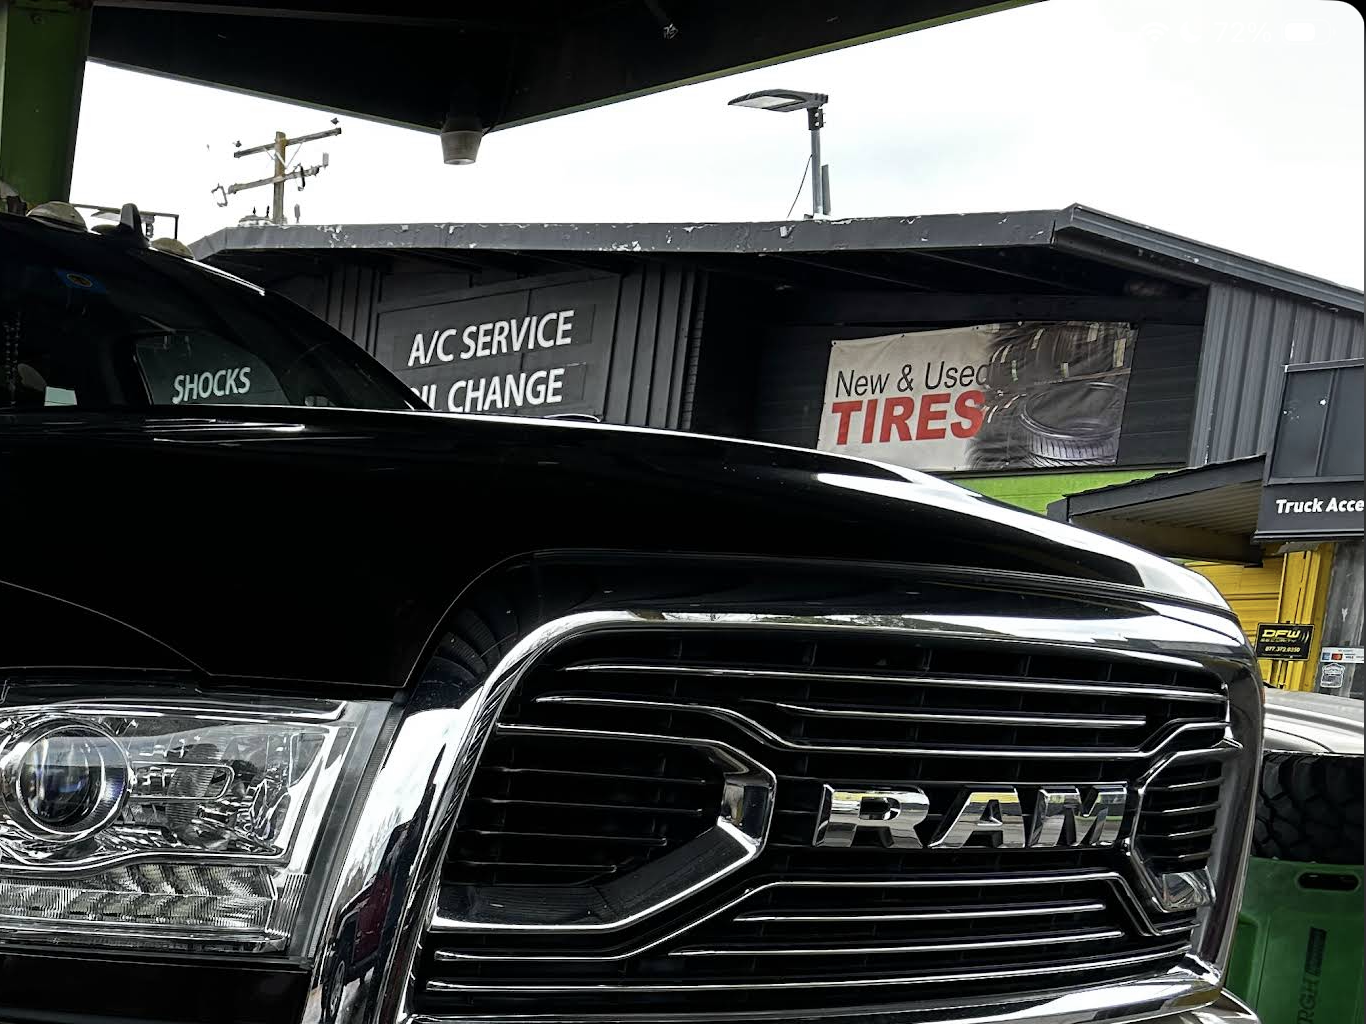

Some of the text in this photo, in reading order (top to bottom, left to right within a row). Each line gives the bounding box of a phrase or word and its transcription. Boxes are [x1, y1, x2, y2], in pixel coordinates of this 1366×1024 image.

[407, 309, 575, 367] A/C SERVICE
[172, 366, 251, 404] SHOCKS
[447, 367, 566, 413] CHANGE
[835, 369, 890, 398] New
[896, 363, 914, 393] &
[831, 389, 987, 446] TIRES
[1275, 497, 1324, 514] Truck
[1261, 629, 1301, 638] DFW
[813, 784, 1128, 850] RAM
